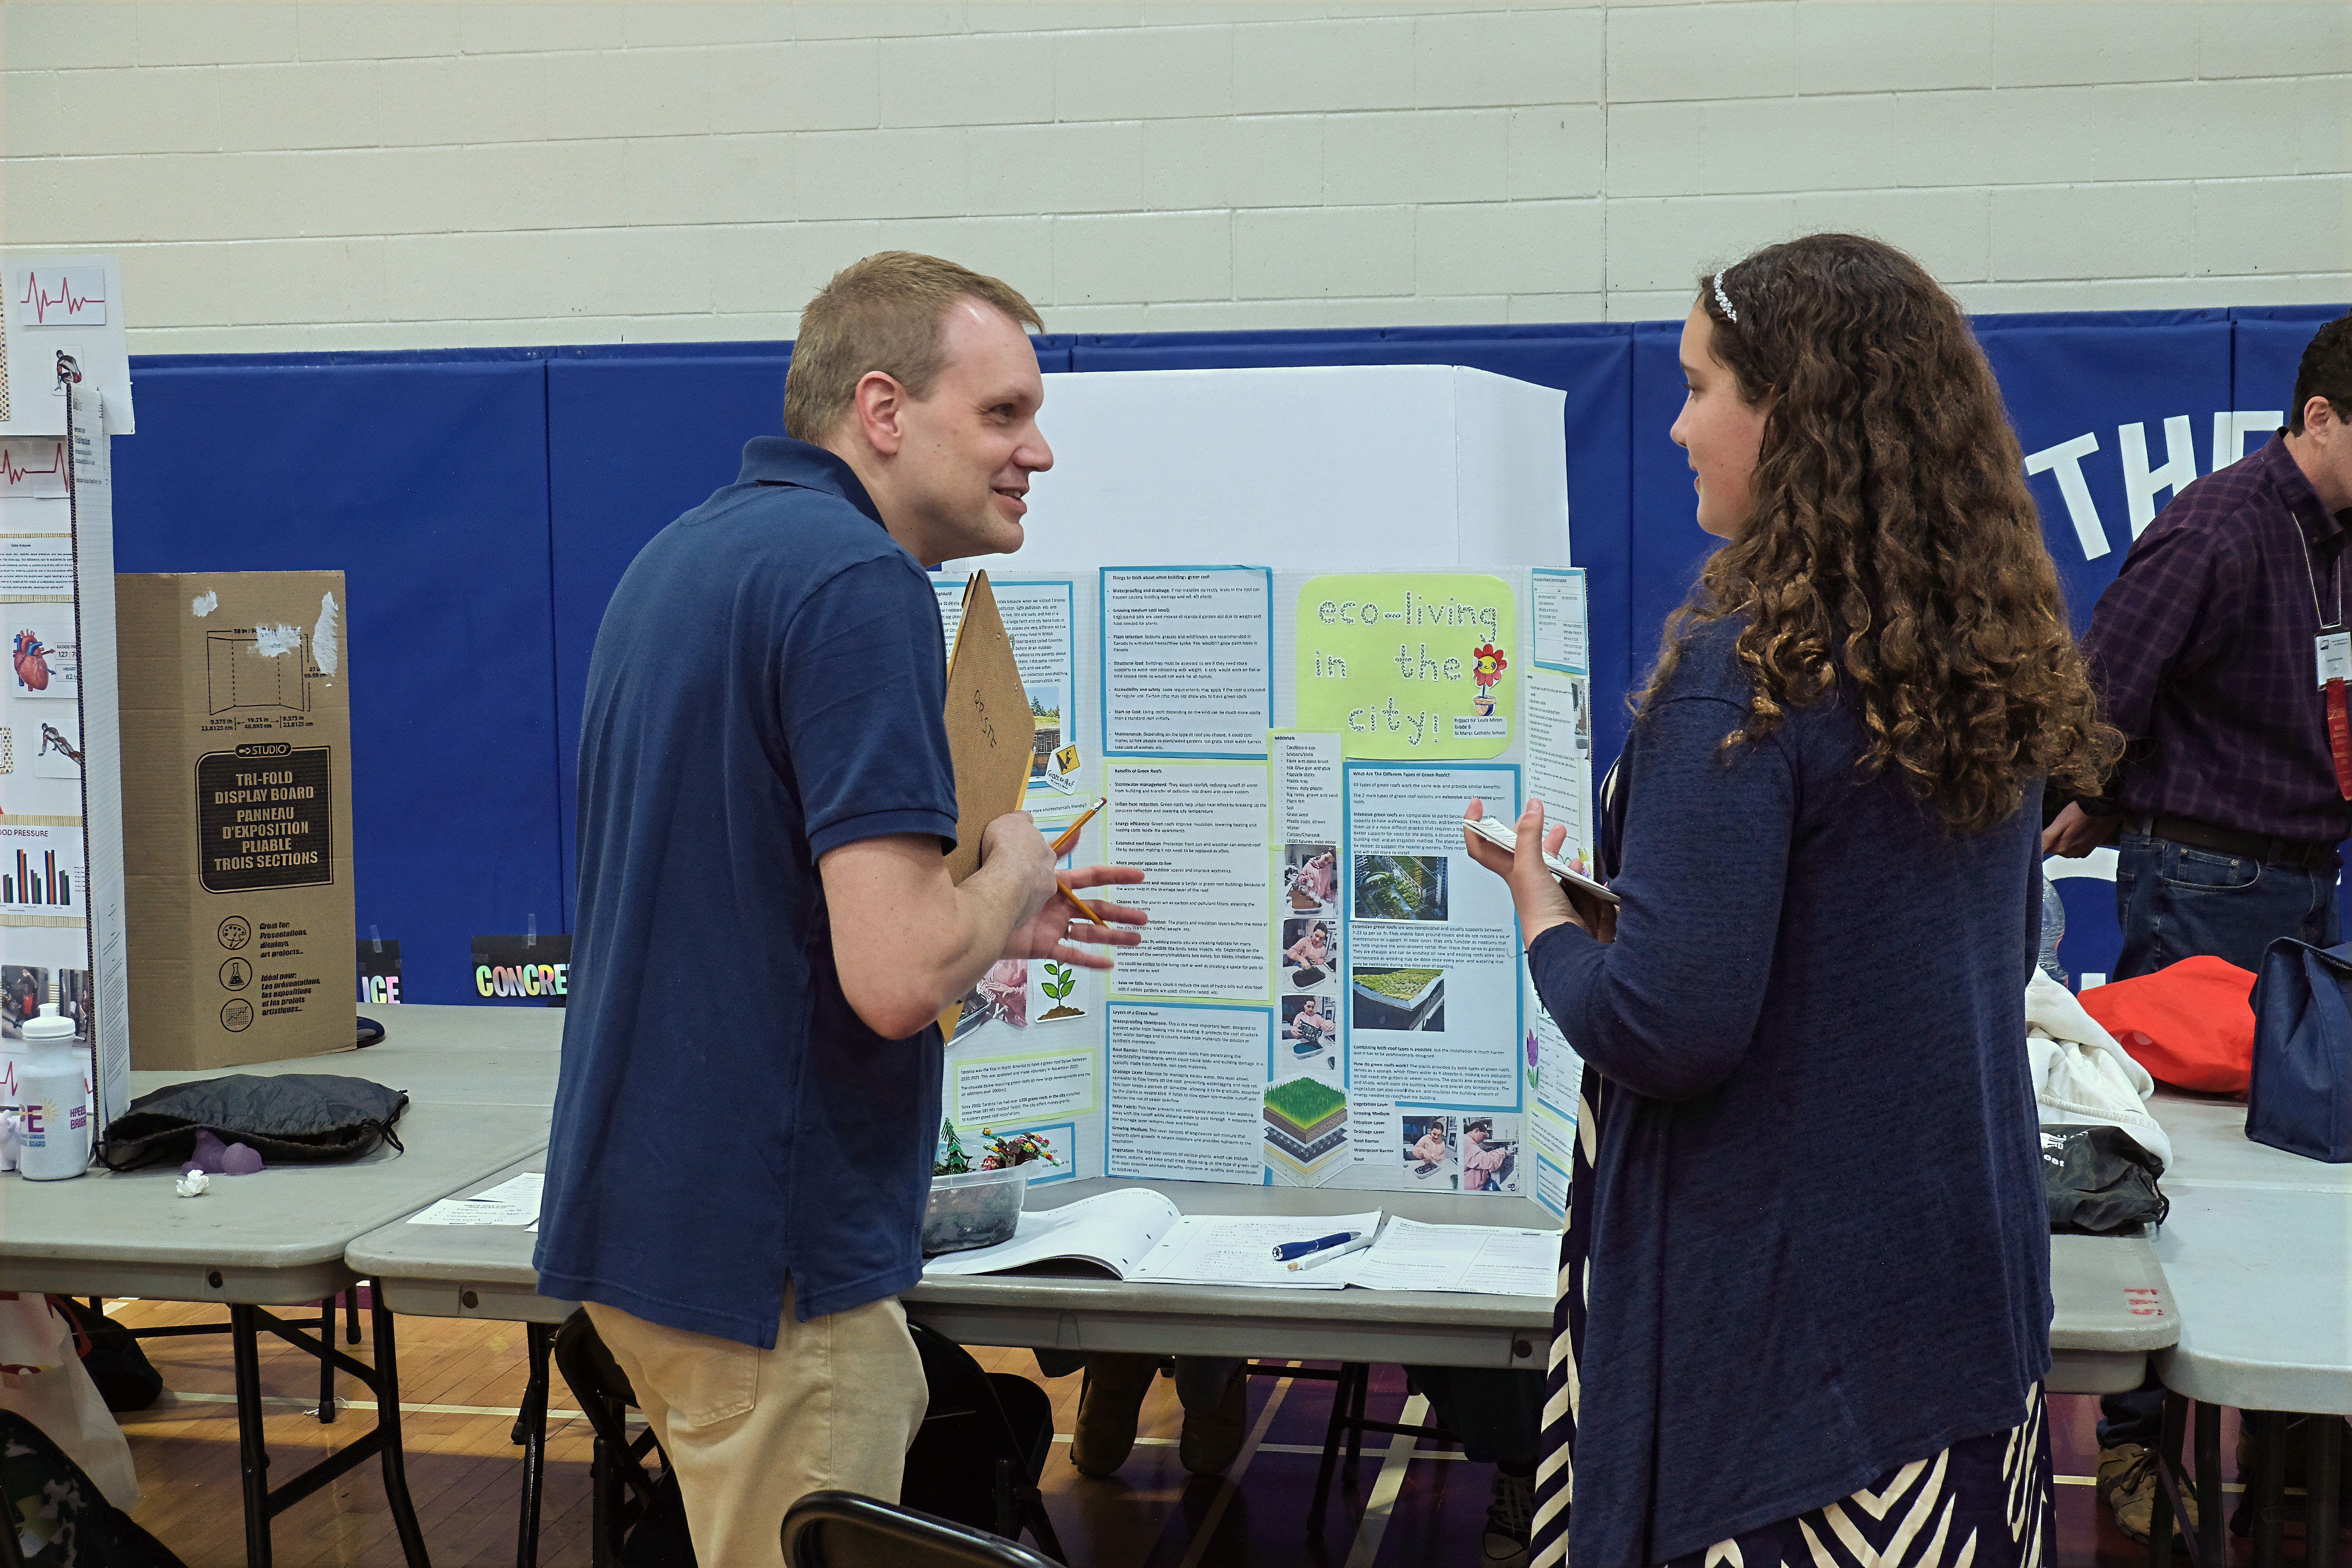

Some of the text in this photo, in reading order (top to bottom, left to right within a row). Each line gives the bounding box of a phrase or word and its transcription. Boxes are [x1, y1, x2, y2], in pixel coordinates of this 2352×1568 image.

[1319, 592, 1497, 643] eco-living
[1315, 644, 1462, 682] in the
[1348, 697, 1439, 747] city!
[236, 771, 293, 787] TRI-FOLD
[215, 786, 314, 804] DISPLAY BOARD
[236, 807, 294, 822] PANNEAU
[14, 829, 49, 837] PRESSURE
[223, 821, 309, 840] D'EXPOSITION
[242, 838, 292, 854] PLIABLE
[214, 851, 318, 871] TROIS SECTIONS
[476, 963, 570, 997] CONCRE
[274, 987, 311, 998] expositions
[361, 975, 401, 1004] ICE
[281, 996, 305, 1005] projets
